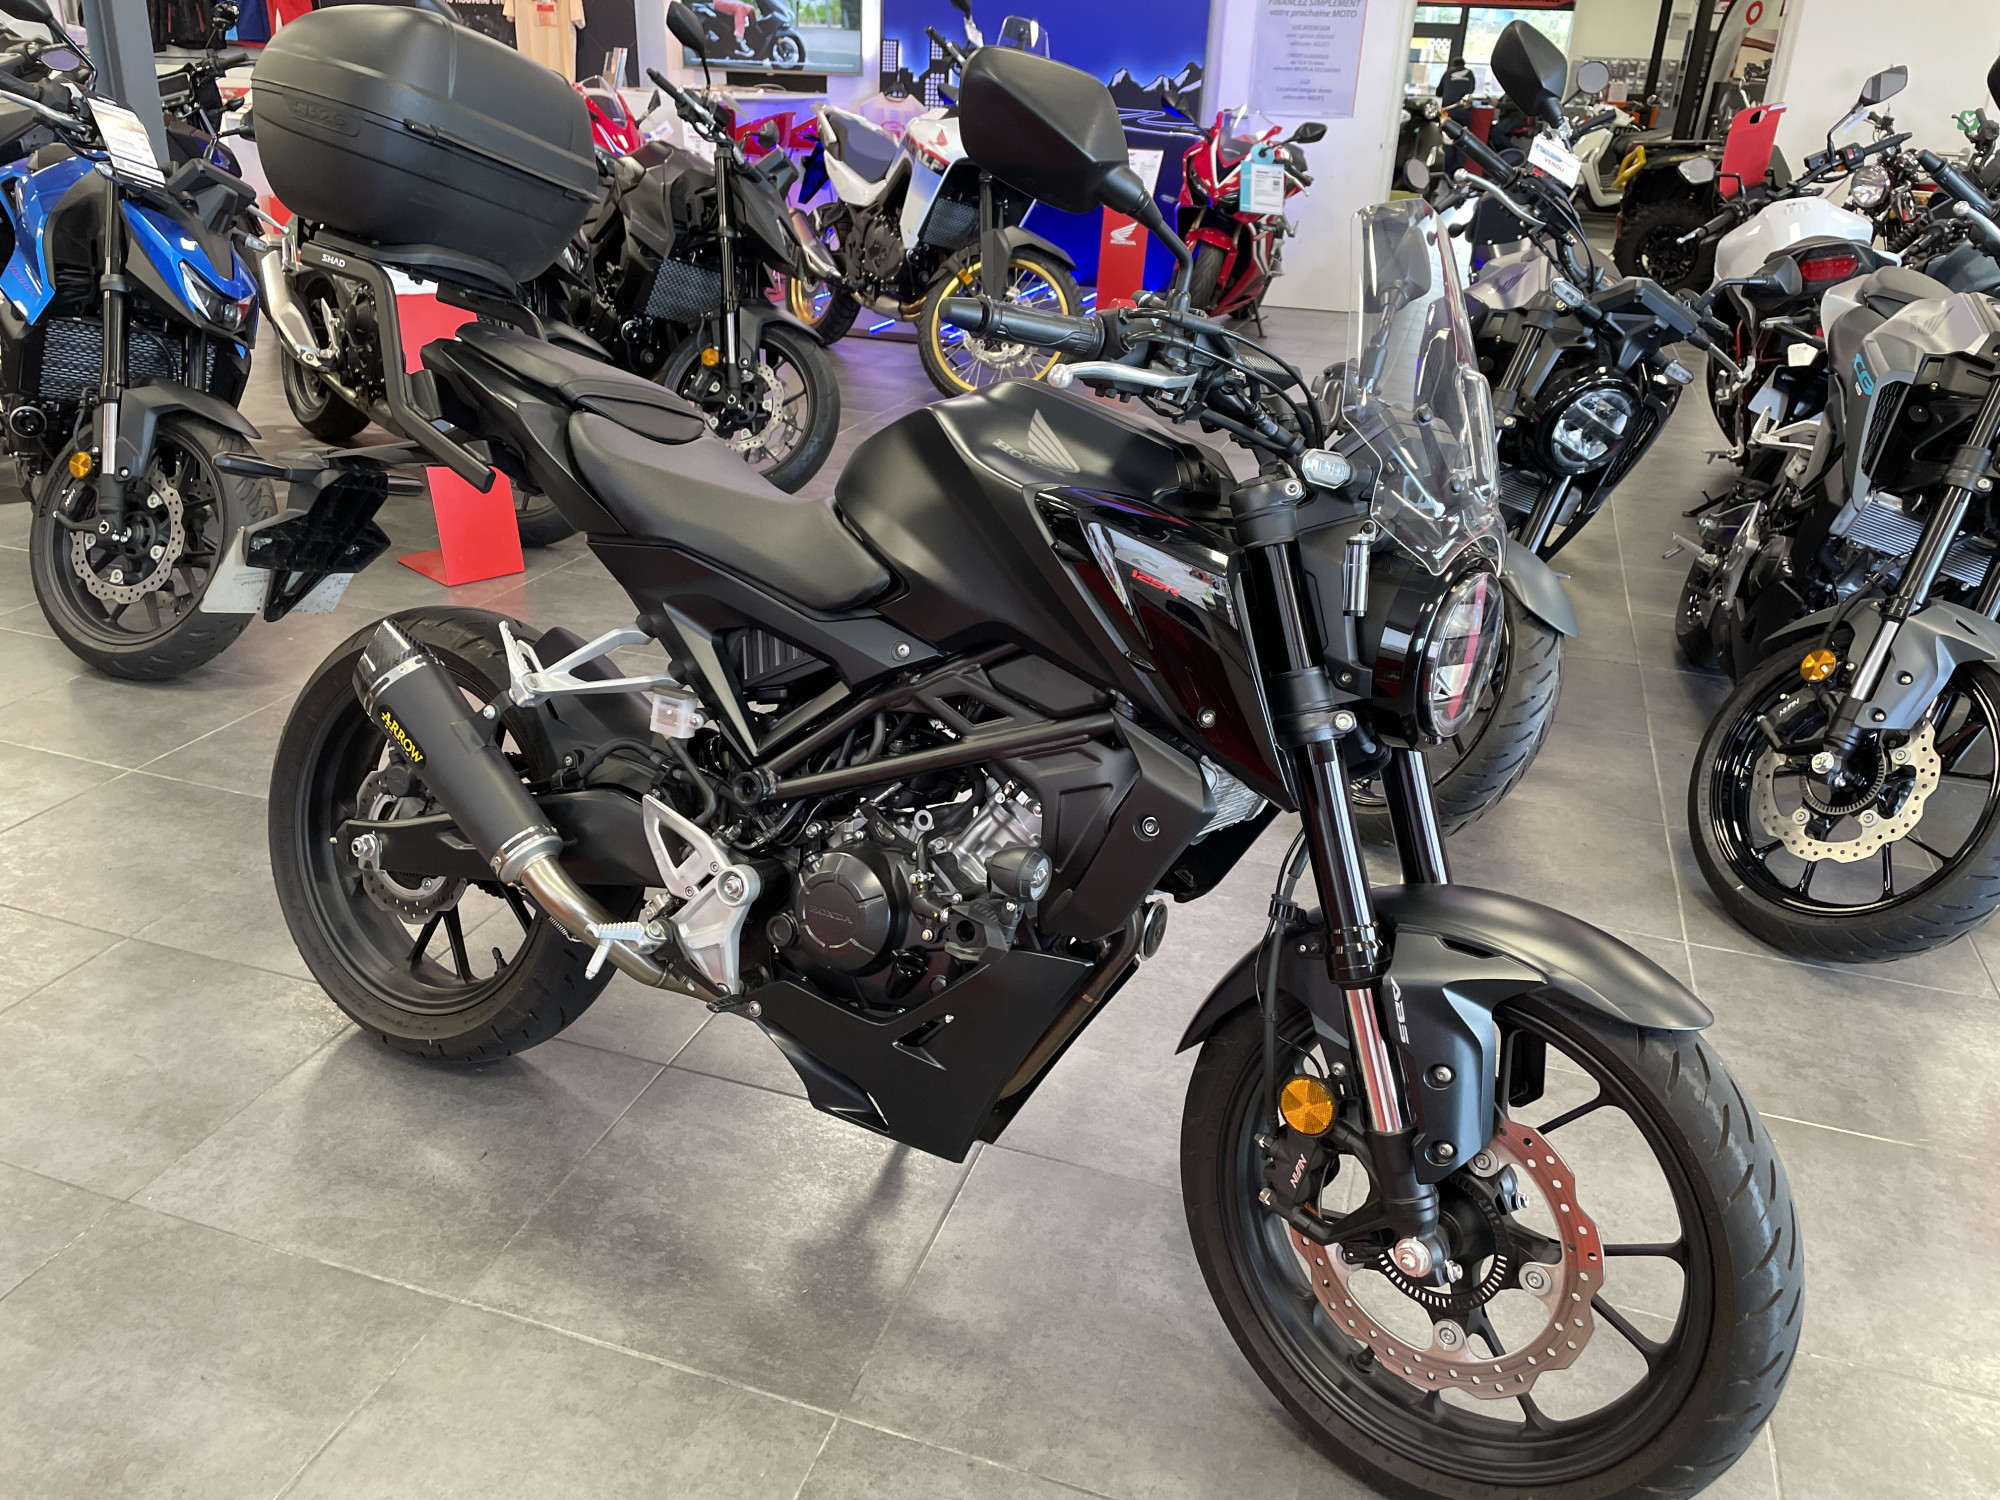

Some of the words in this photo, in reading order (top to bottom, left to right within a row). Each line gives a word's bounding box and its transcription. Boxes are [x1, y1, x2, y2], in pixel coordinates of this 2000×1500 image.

[1290, 9, 1331, 18] prochaine
[1331, 9, 1358, 18] MOTO
[1308, 0, 1361, 8] SIMPLEMENT
[1545, 157, 1565, 173] VENDU
[321, 253, 346, 268] SHAD
[1131, 569, 1180, 597] 125R
[381, 711, 424, 763] ARROW
[809, 903, 854, 925] HONDA
[1390, 975, 1410, 1045] ABS
